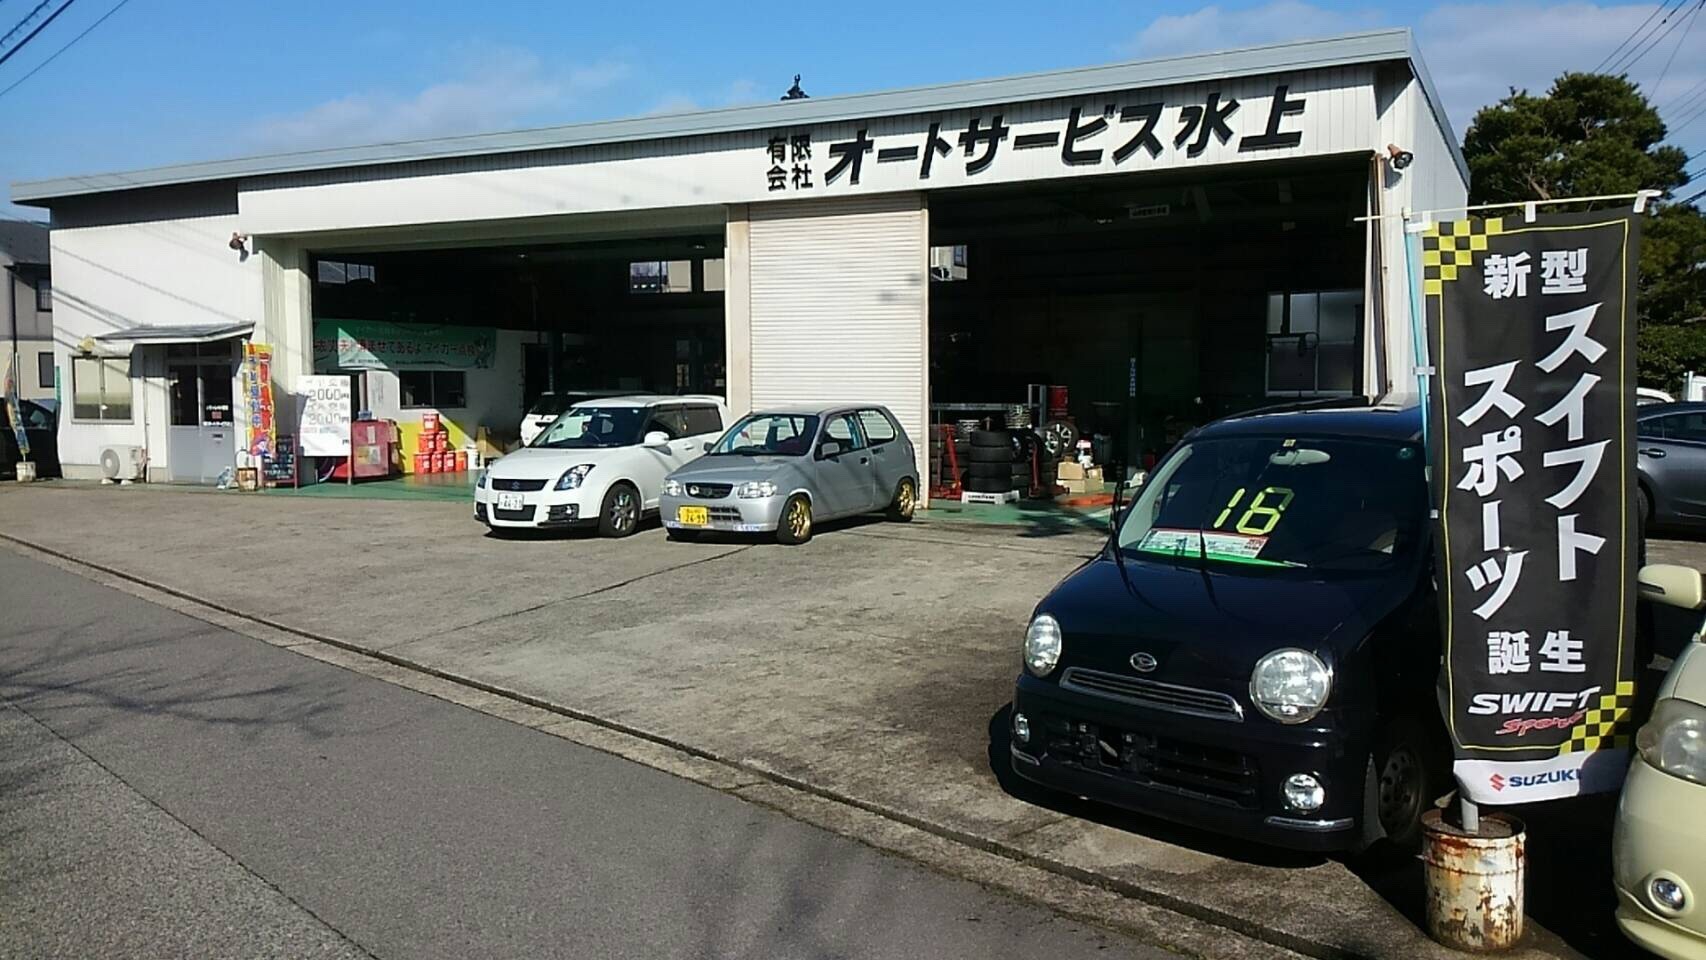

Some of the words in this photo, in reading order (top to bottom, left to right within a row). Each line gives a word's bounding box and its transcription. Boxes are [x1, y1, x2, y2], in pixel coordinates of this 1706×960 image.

[767, 134, 812, 164] 有限
[824, 85, 1306, 186] オートサービス水上
[767, 164, 813, 191] 会社
[1484, 248, 1588, 299] 新型
[1534, 302, 1612, 582] スイフト
[1456, 360, 1529, 620] スポーツ
[1487, 630, 1586, 674] 誕生
[1468, 686, 1601, 715] SWIFT
[1495, 708, 1588, 737] Sport
[1509, 768, 1582, 787] SUZUKI
